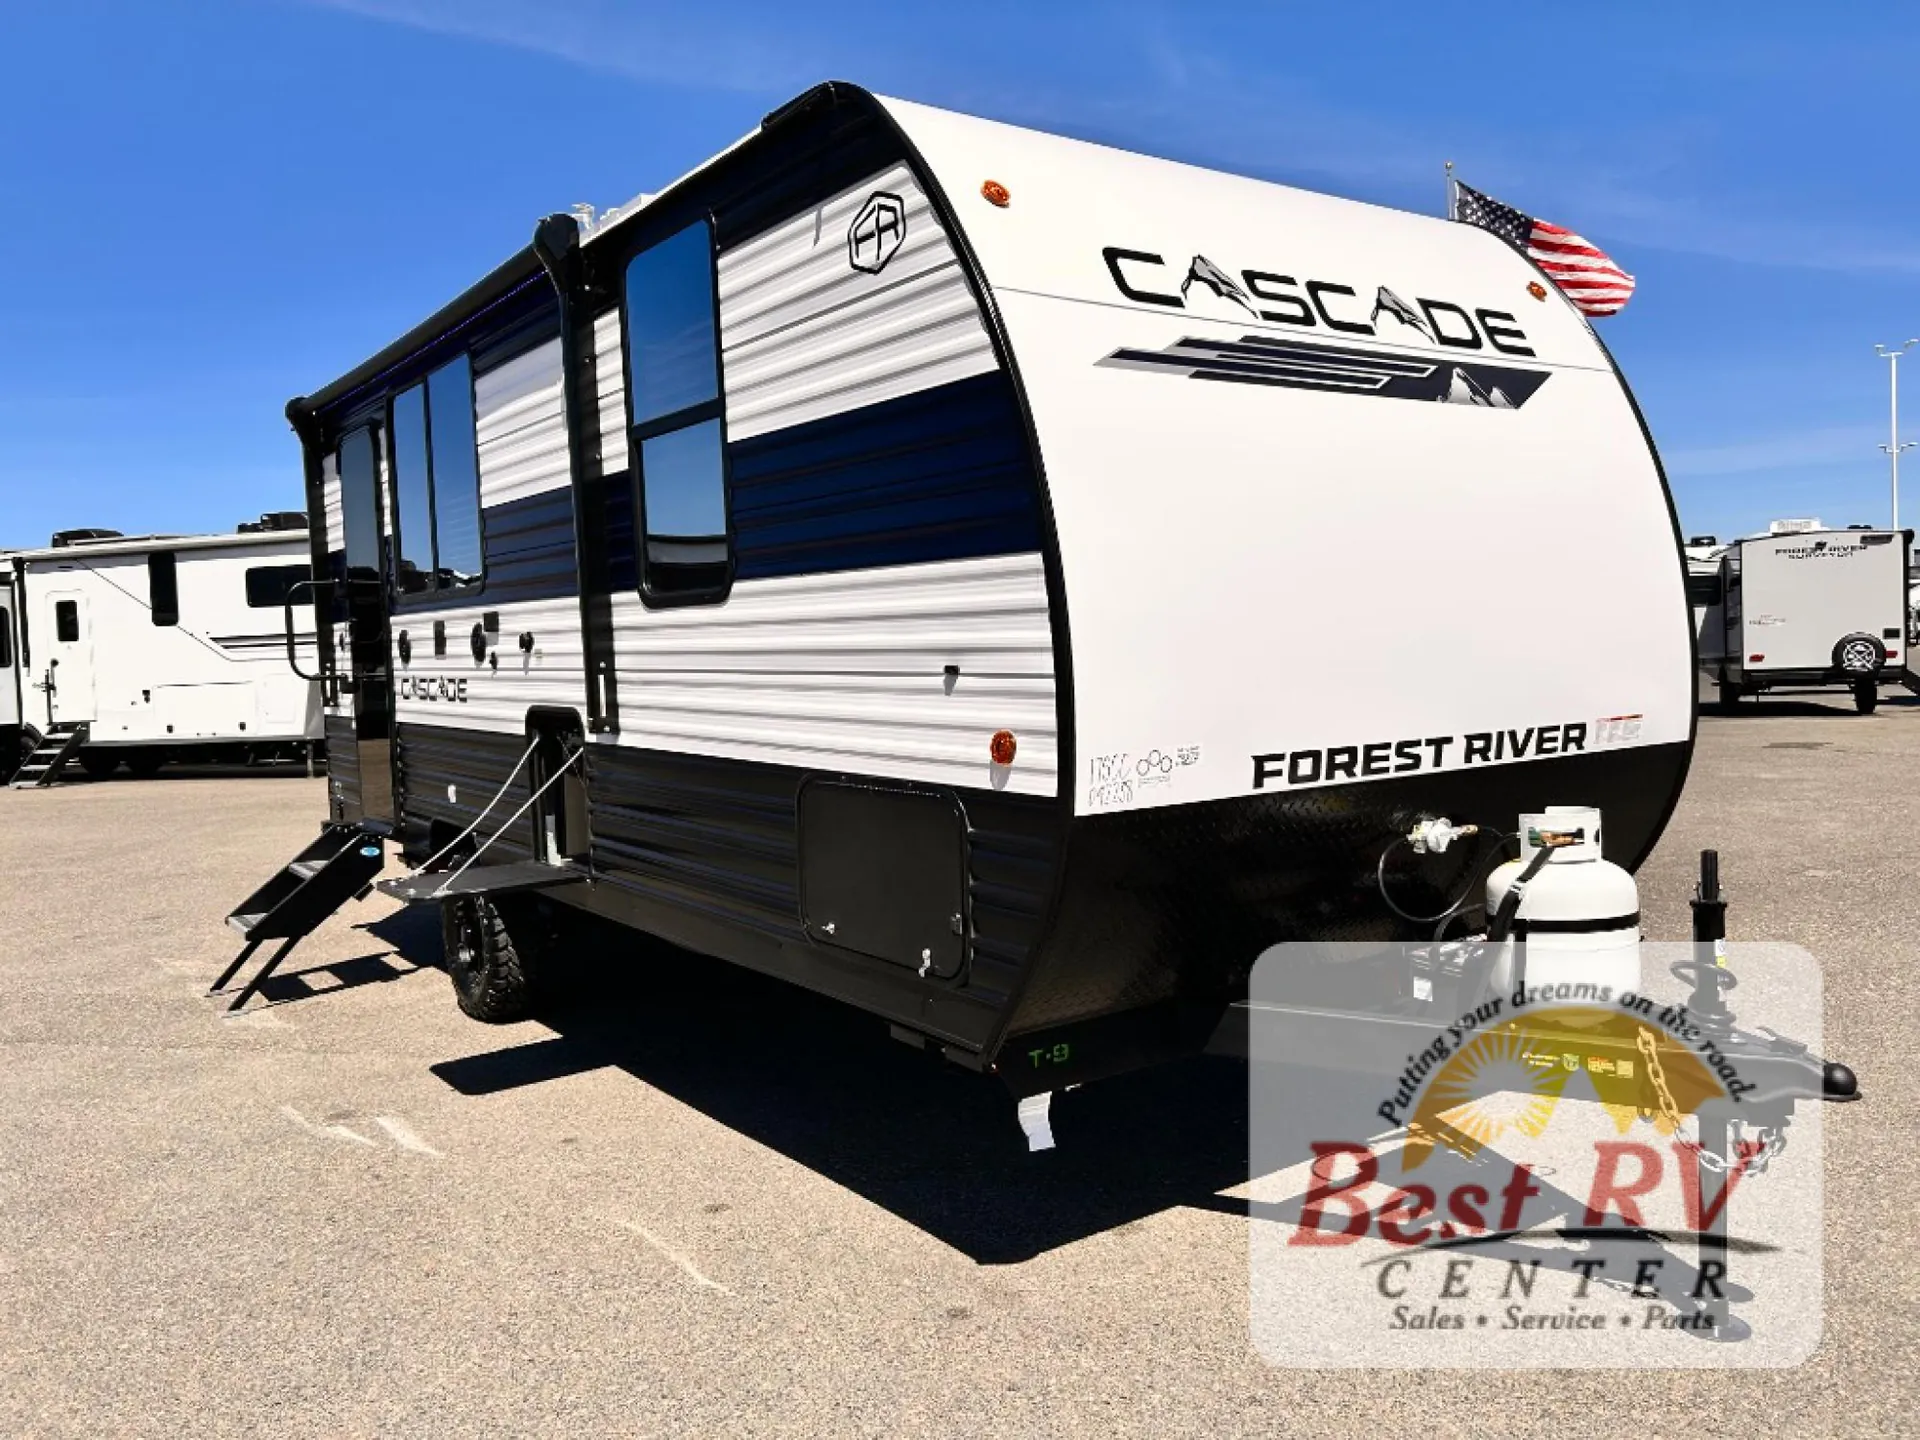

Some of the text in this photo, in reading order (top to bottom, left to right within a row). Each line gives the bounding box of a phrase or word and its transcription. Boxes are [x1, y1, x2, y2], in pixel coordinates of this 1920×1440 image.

[1102, 246, 1537, 357] CASCADE
[401, 675, 468, 703] CASCADE
[1251, 736, 1454, 789] FOREST
[1463, 722, 1587, 764] RIVER
